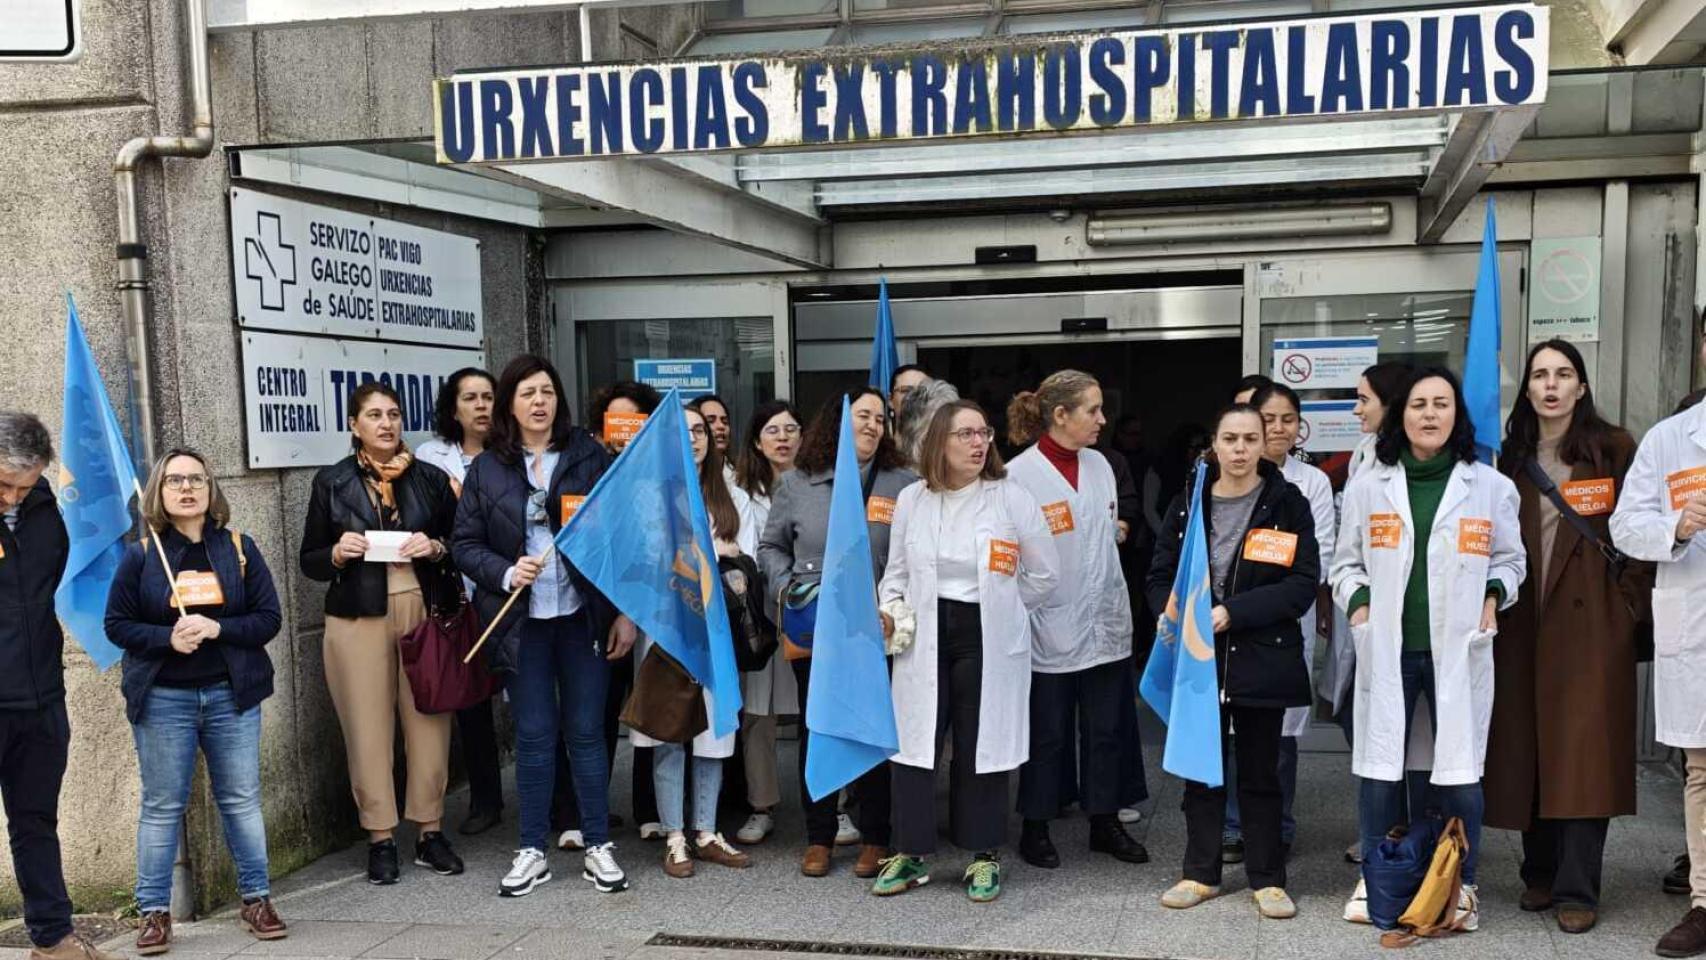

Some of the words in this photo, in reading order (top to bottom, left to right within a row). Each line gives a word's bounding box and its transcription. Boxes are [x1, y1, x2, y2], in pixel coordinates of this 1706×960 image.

[442, 62, 769, 163] URXENCIAS
[801, 10, 1535, 142] EXTRAHOSPITALARIAS
[309, 221, 371, 255] SERVIZO
[379, 236, 399, 261] PAC
[400, 241, 422, 265] VIGO
[311, 258, 372, 288] GALEGO
[380, 268, 433, 298] URXENCIAS
[303, 289, 322, 316] de
[329, 283, 374, 322] SAÚDE
[382, 304, 476, 332] EXTRAHOSPITALARIAS
[257, 366, 307, 398] CENTRO
[330, 370, 438, 432] TAADA
[259, 403, 321, 432] INTEGRAL
[1463, 523, 1491, 536] MÉDIC
[1465, 541, 1490, 551] HUEL
